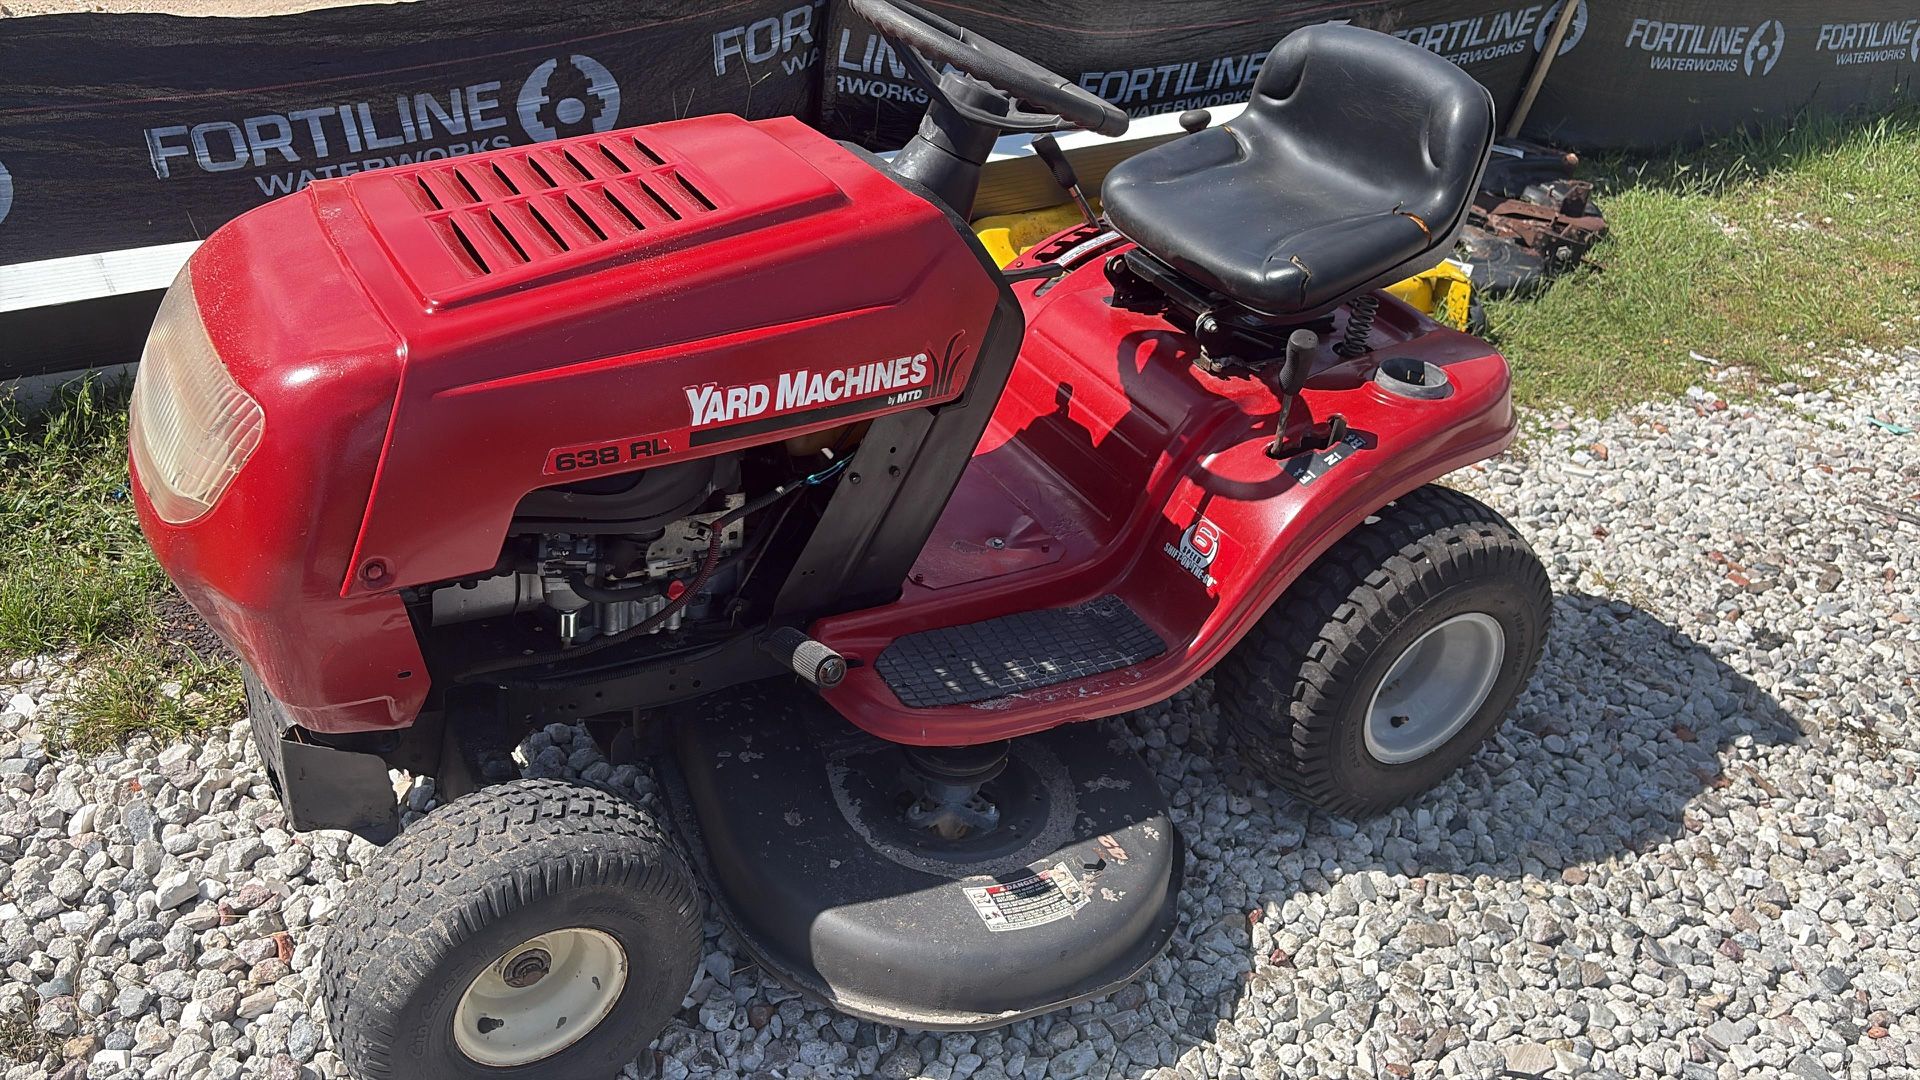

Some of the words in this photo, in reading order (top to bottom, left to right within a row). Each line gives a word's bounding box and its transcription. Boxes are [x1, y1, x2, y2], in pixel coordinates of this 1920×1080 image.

[1625, 18, 1749, 55] FORTILINE
[1815, 19, 1918, 51] FORTILINE
[1442, 40, 1526, 66] ERWORKS
[1650, 56, 1738, 72] WATERWORKS
[1836, 48, 1906, 65] WATERWORKS
[144, 81, 506, 180] FORTILINE
[684, 384, 770, 427] YARD
[775, 353, 928, 412] MACHINES
[896, 389, 923, 405] MTD
[555, 446, 620, 472] 638
[630, 439, 670, 460] RL
[1190, 519, 1220, 556] 6
[1182, 546, 1202, 565] SPEED
[1006, 876, 1041, 891] DANGER
